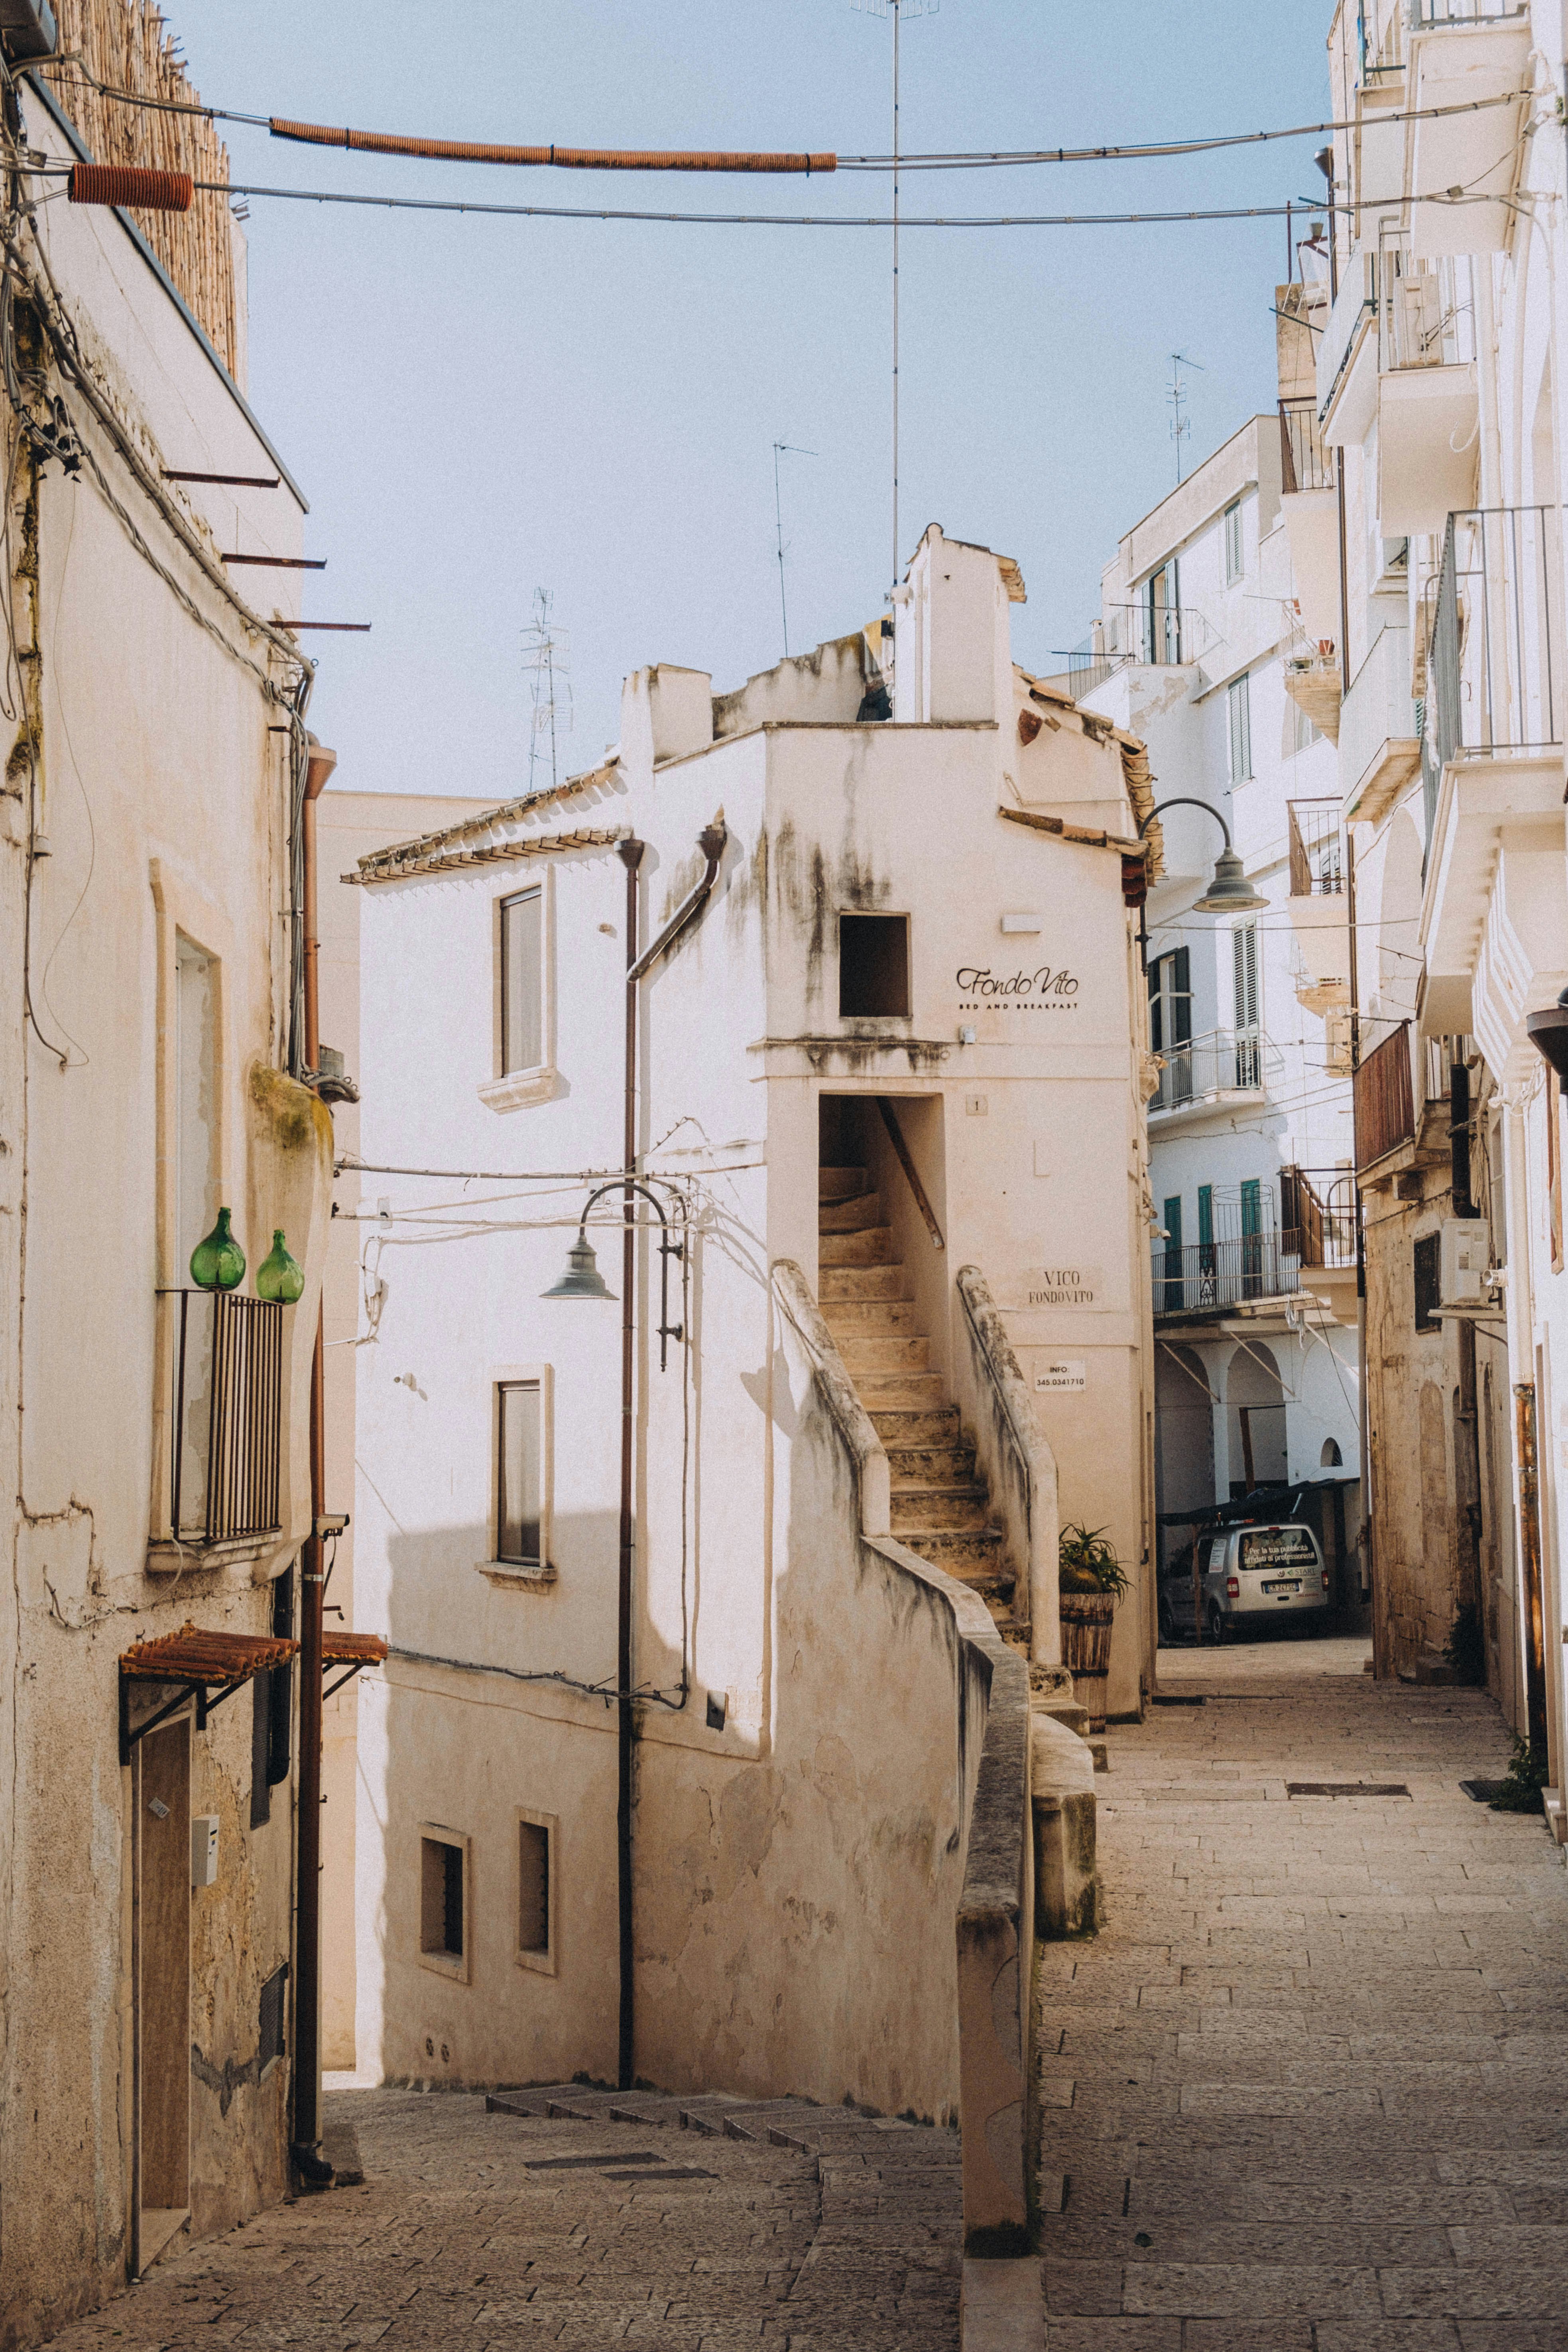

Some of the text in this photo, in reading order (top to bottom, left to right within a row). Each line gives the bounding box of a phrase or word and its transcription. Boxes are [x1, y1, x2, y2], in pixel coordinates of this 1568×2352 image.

[957, 967, 1078, 995] Fondo Vito
[1044, 1271, 1080, 1286] VICO
[1029, 1291, 1093, 1303] FONDOVITO
